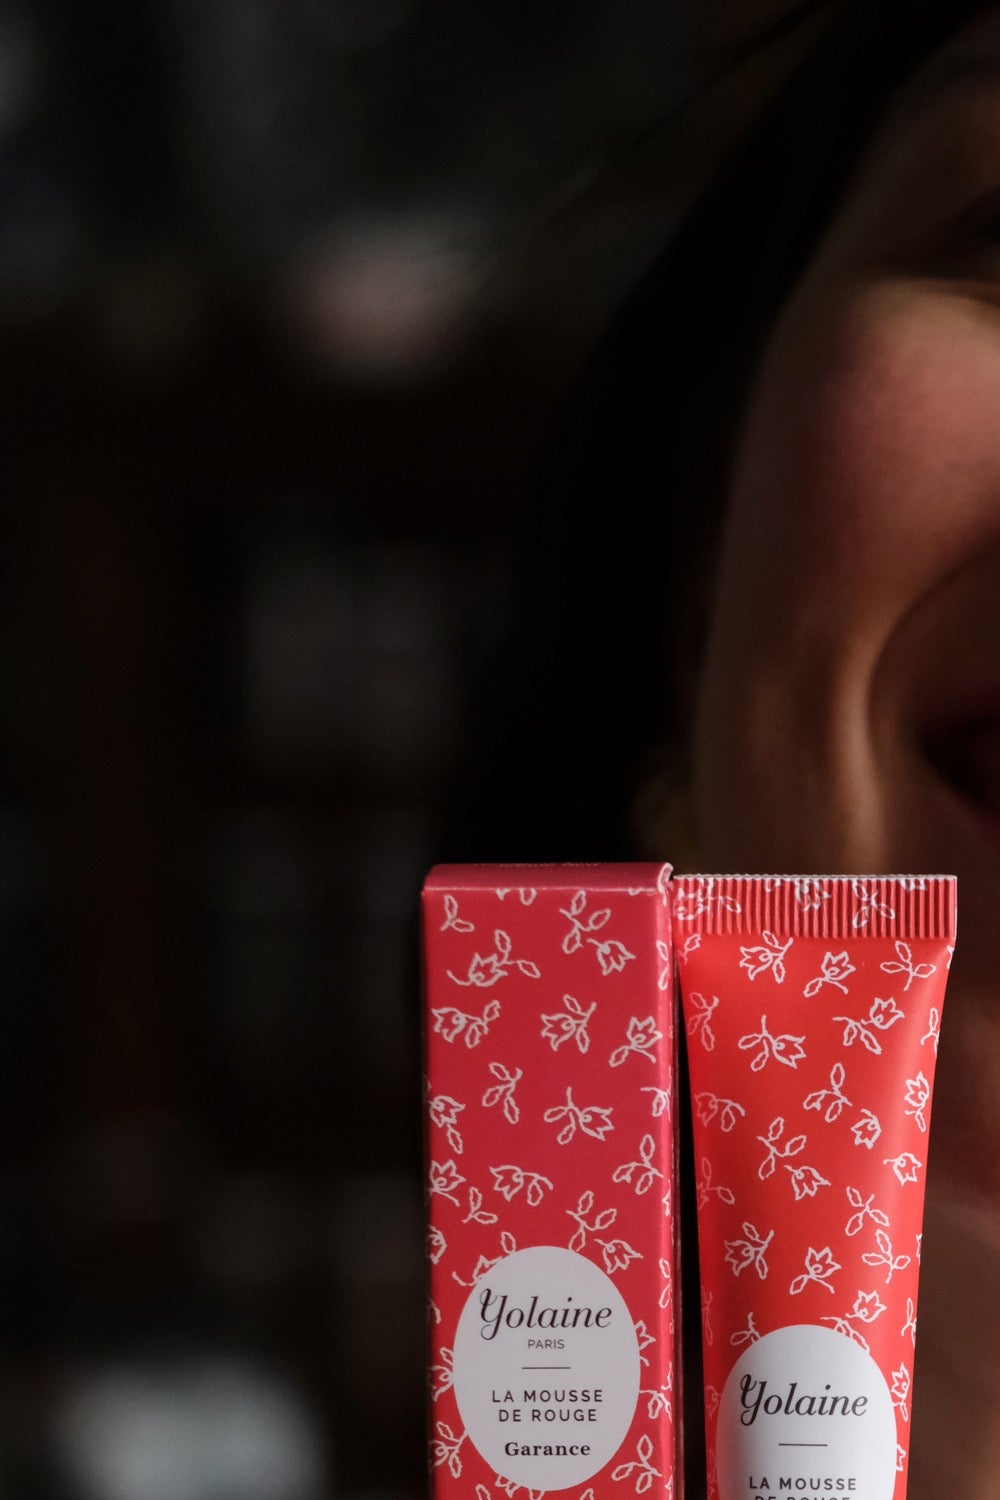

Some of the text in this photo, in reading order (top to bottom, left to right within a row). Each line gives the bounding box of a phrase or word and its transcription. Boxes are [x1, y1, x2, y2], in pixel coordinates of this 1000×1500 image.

[479, 1288, 613, 1341] Yolaine
[527, 1338, 565, 1350] PARIS
[491, 1389, 603, 1404] LA MOUSSE
[740, 1373, 868, 1427] Yolaine
[498, 1408, 597, 1423] DE ROUGE
[504, 1441, 591, 1457] Garance
[748, 1475, 857, 1492] LA MOUSSE
